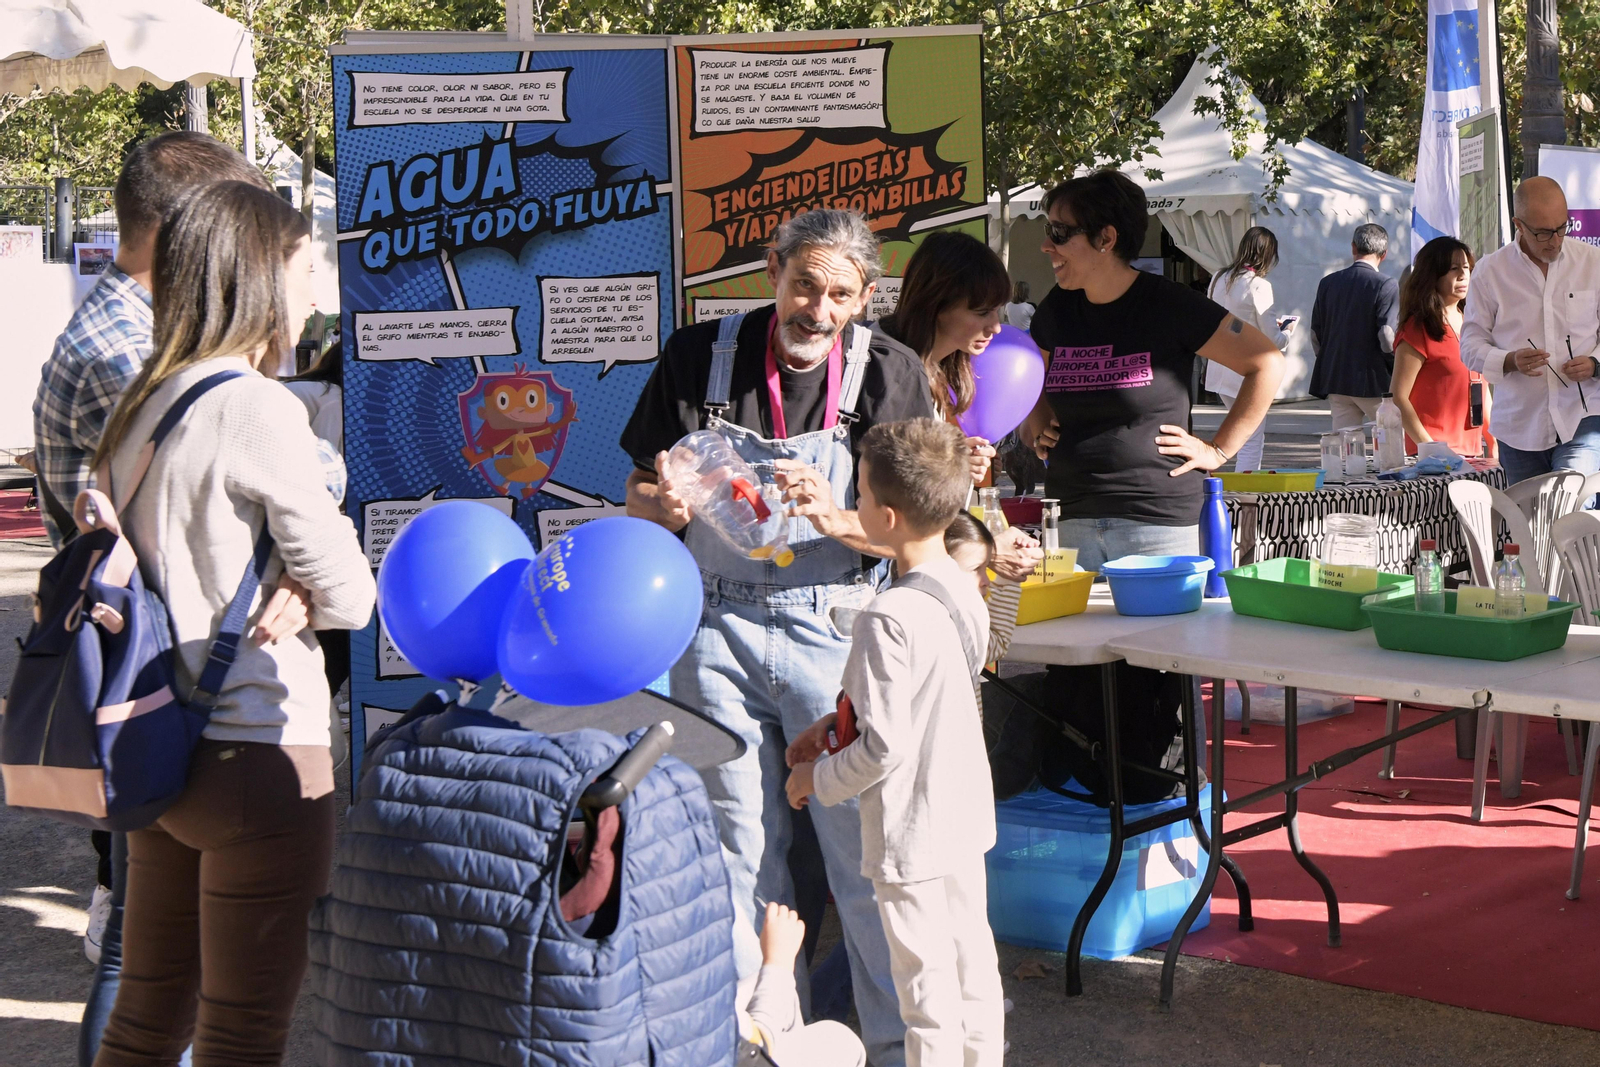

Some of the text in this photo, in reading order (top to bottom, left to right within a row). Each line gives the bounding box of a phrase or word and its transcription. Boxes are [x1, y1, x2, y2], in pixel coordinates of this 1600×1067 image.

[756, 58, 787, 67] ENERGÍA
[849, 67, 876, 75] EMPIE-
[736, 117, 754, 125] DAÑA
[359, 142, 515, 223] AGUA
[714, 150, 906, 221] ENCIENDE IDEAS
[1177, 199, 1185, 208] 7
[363, 181, 652, 268] QUE TODO FLUYA
[725, 222, 741, 247] Y
[748, 198, 826, 242] APA
[605, 283, 631, 291] ALGÚN
[562, 325, 588, 334] ALGÚN
[1055, 347, 1110, 358] LA NOCHE
[1051, 355, 1146, 371] EUROPEA DE L@S
